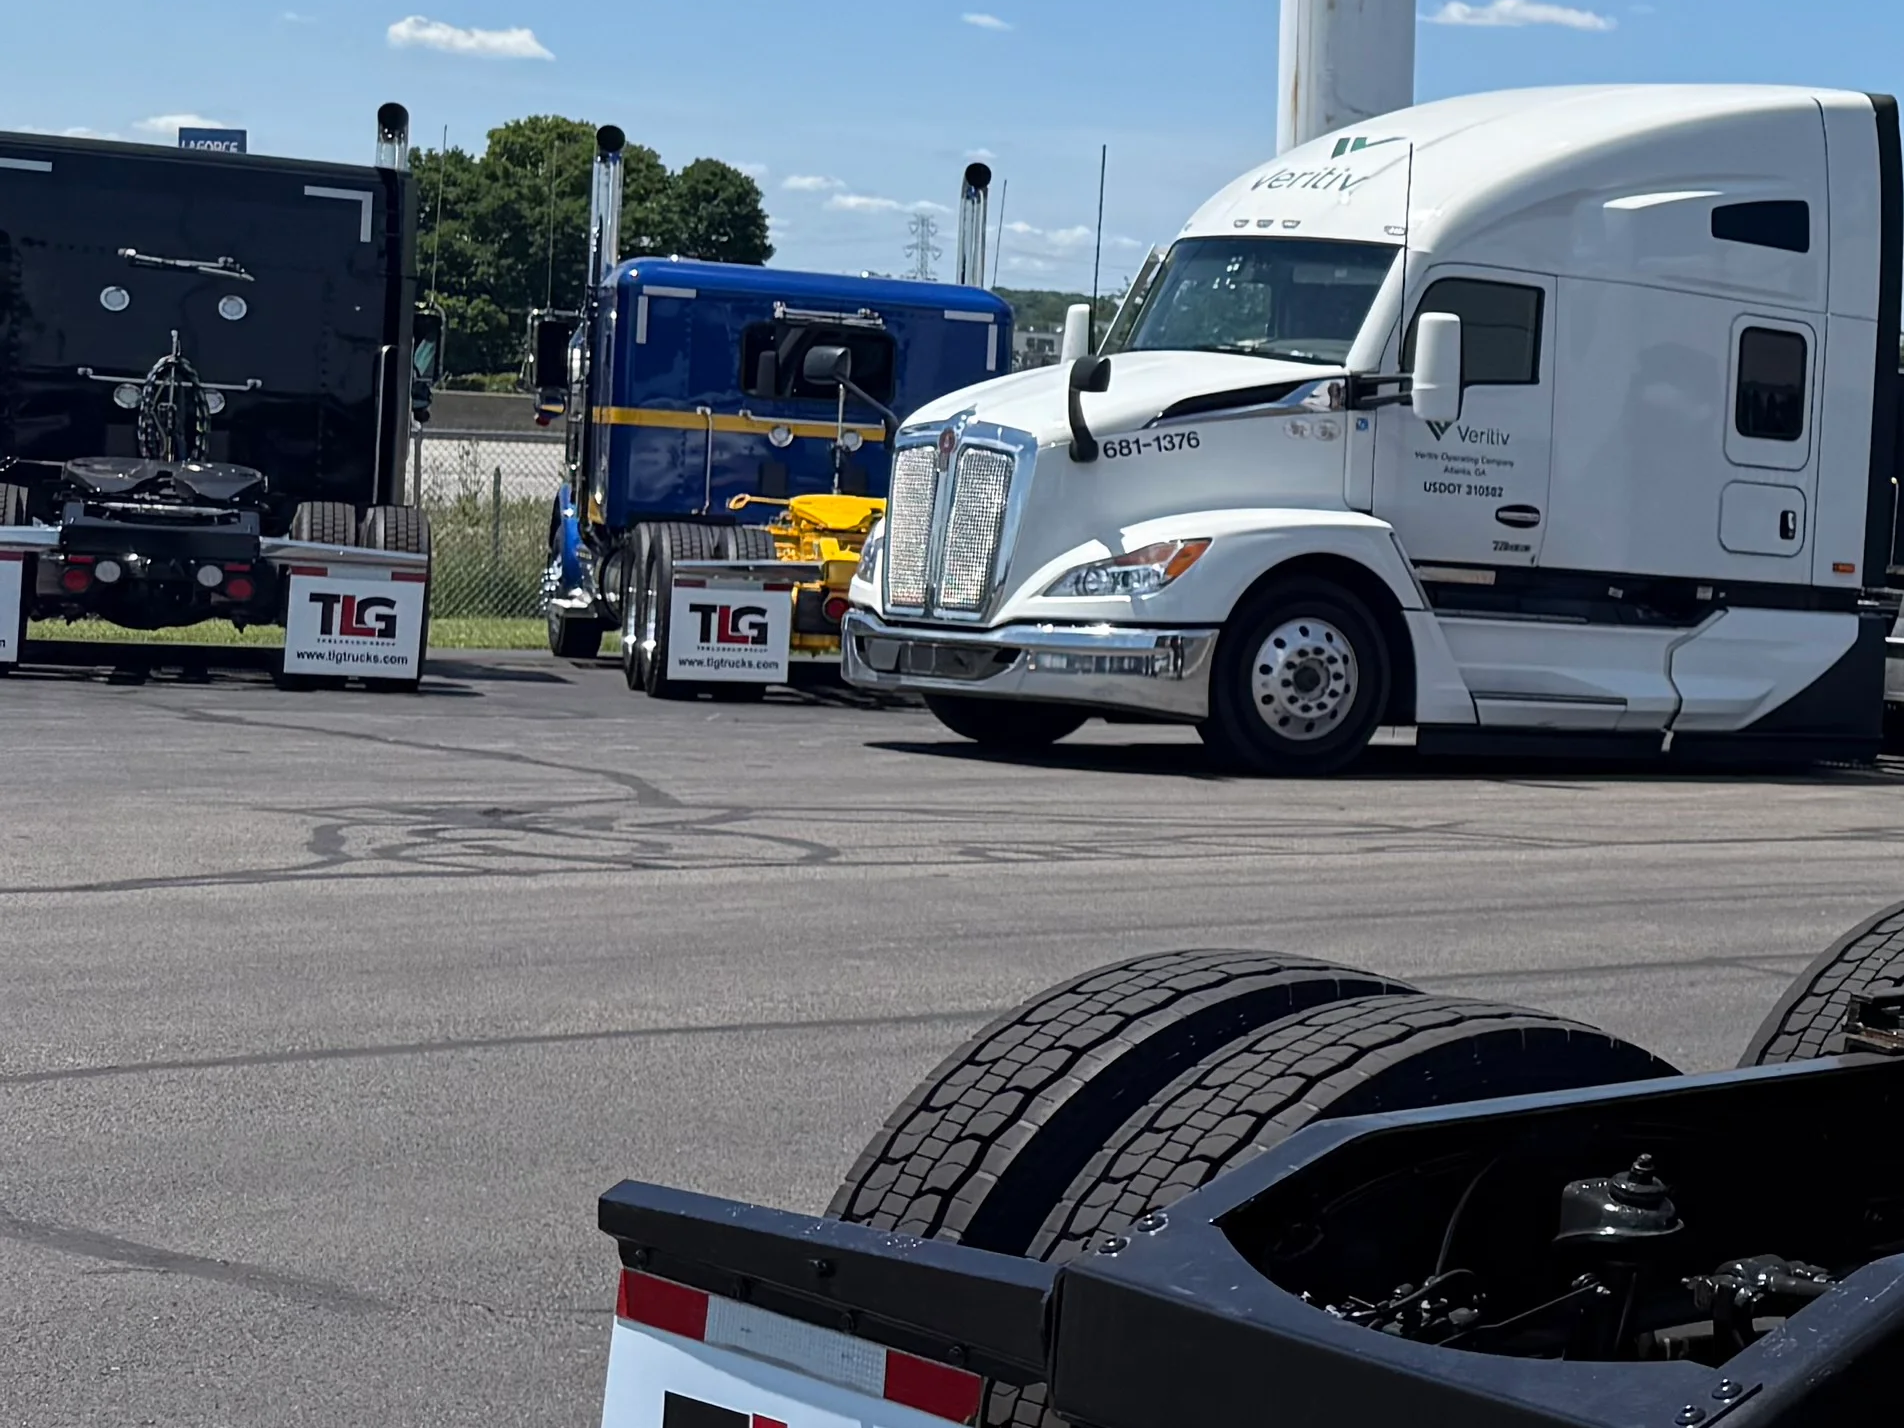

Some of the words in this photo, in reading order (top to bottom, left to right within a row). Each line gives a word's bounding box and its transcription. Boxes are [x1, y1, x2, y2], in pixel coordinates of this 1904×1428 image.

[1251, 166, 1370, 192] Veritiv
[1103, 431, 1200, 459] 681-1376
[1457, 424, 1510, 445] Veritiv
[1423, 481, 1461, 494] USDOT
[309, 592, 397, 639] TLG
[689, 603, 768, 645] TLG
[296, 650, 408, 665] www.tlgtrucks.com
[678, 656, 779, 670] www.tlgtrucks.com
